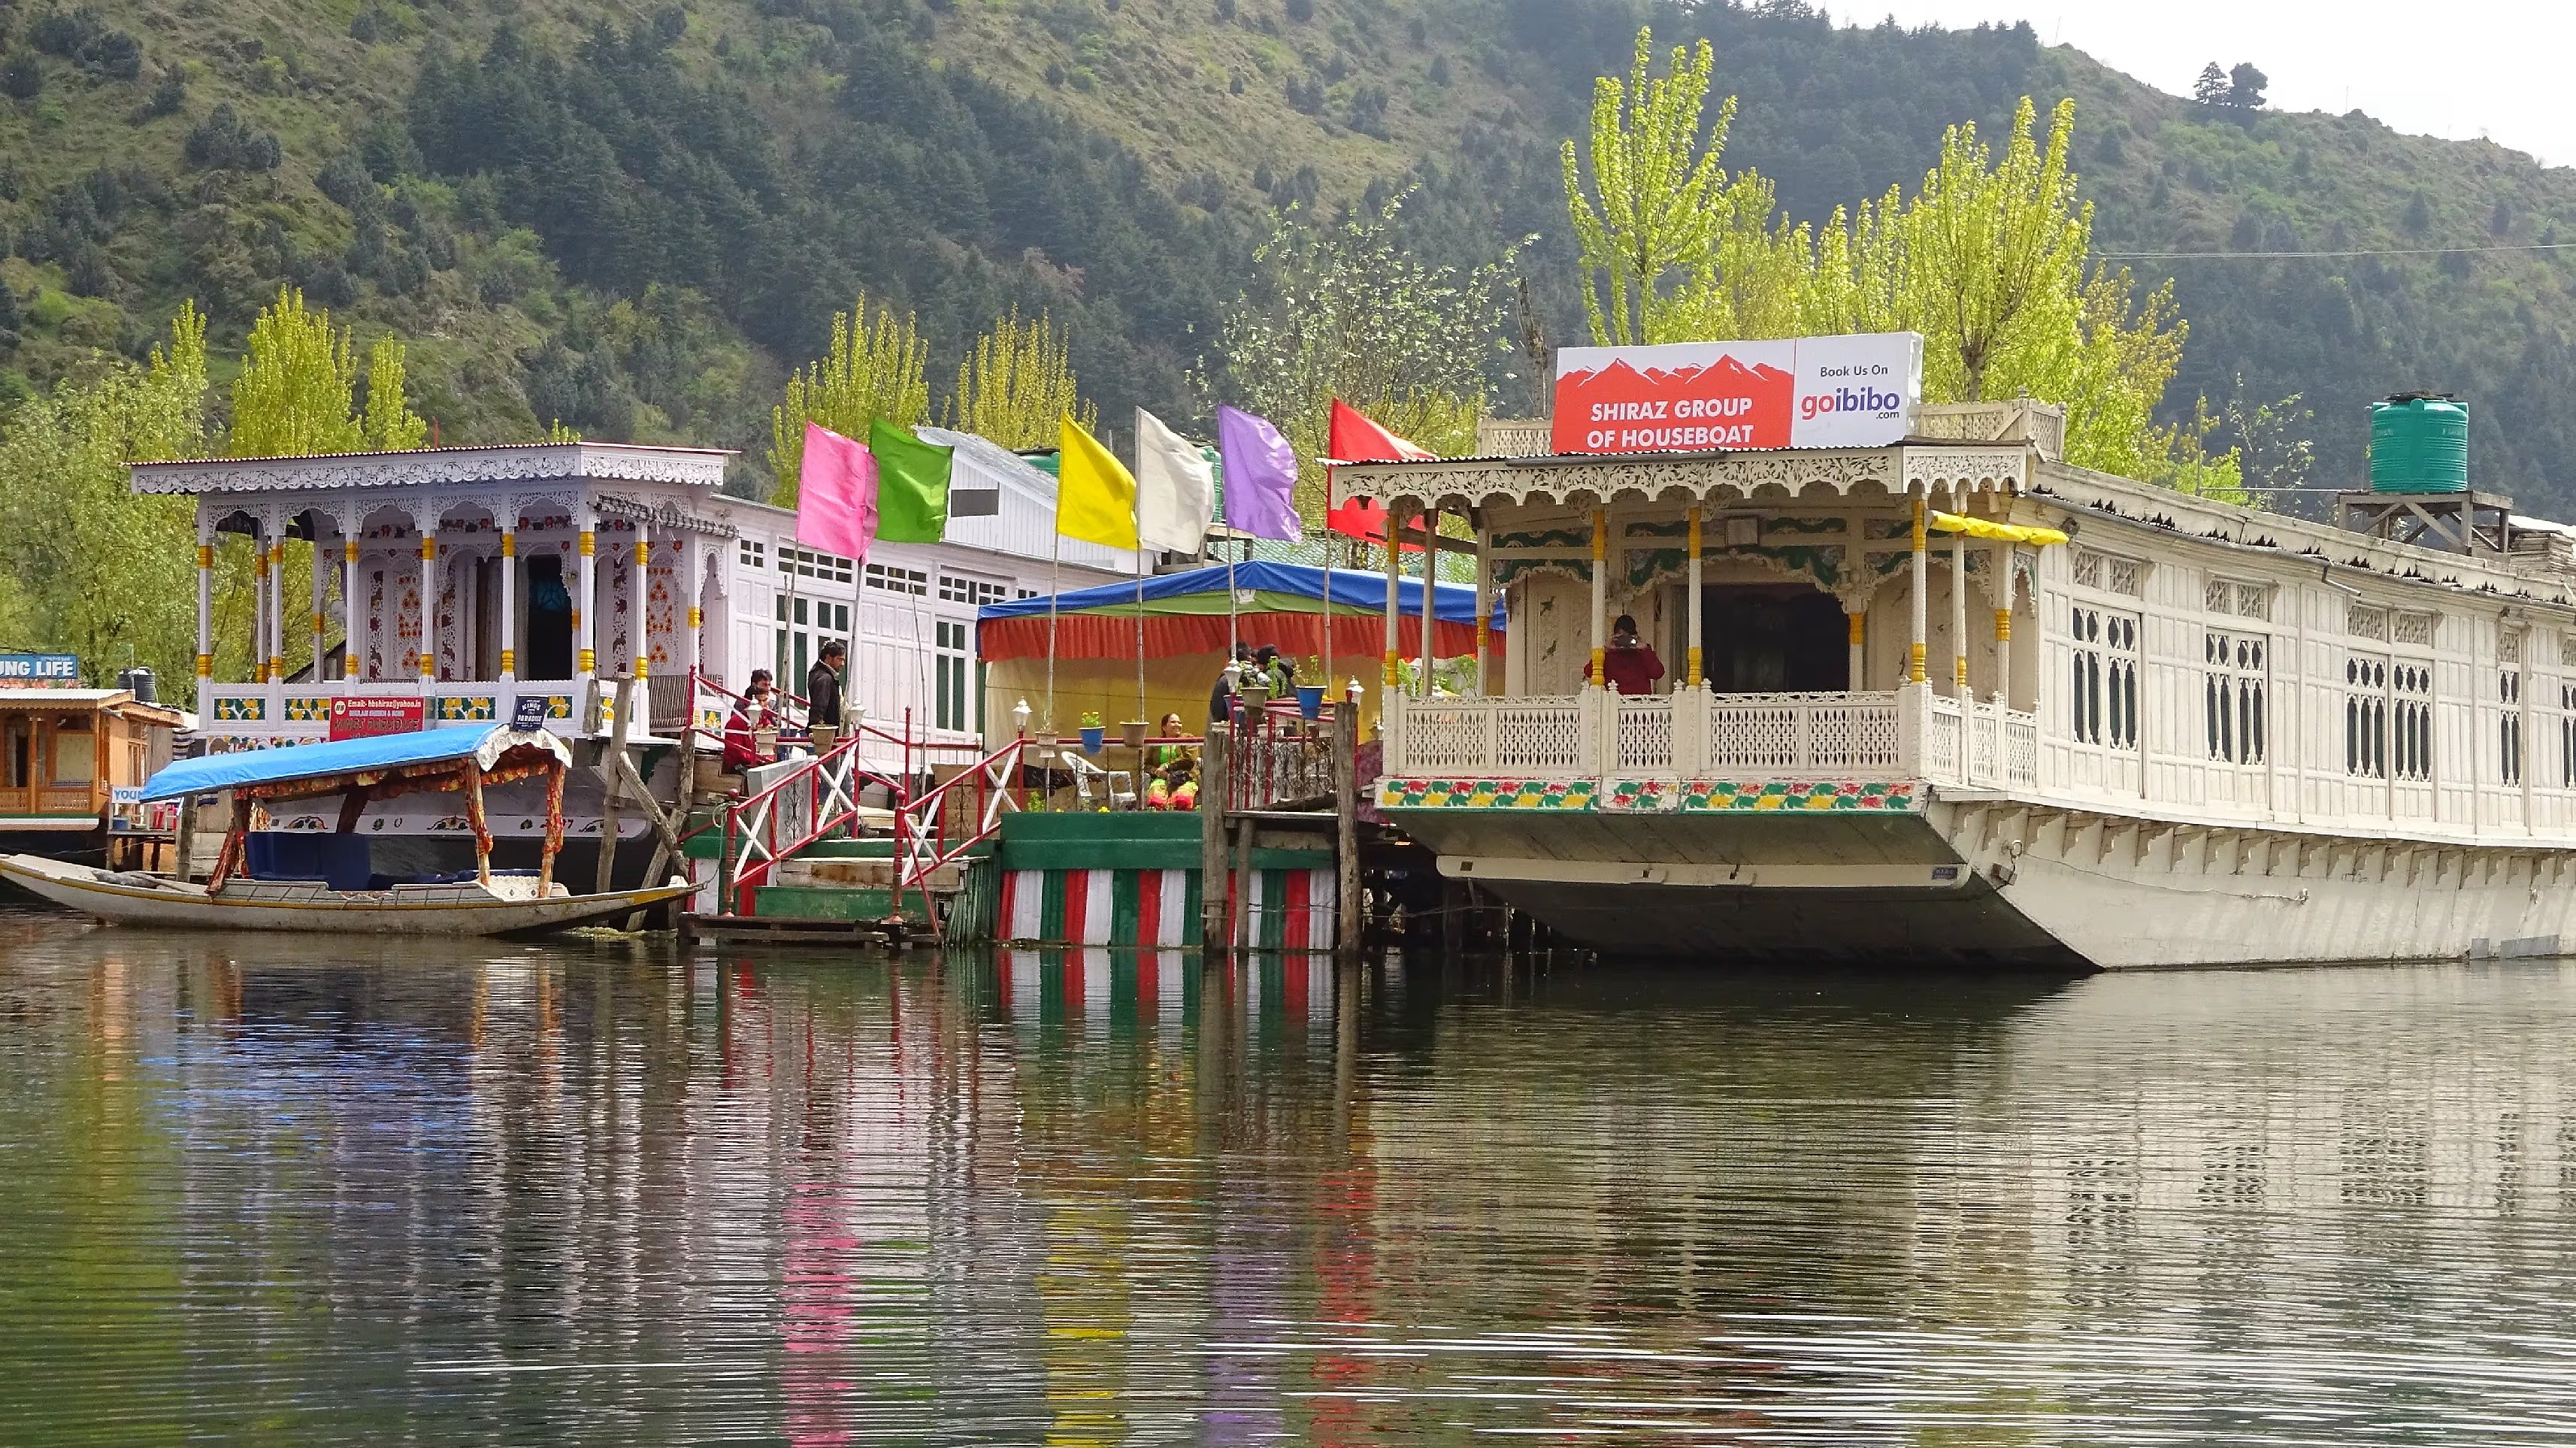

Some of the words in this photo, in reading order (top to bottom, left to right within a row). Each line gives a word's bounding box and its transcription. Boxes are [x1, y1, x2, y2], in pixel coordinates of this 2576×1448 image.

[1820, 366, 1850, 377] Book
[1854, 365, 1868, 376] Us
[1871, 365, 1888, 375] On
[1591, 401, 1669, 422] SHIRAZ
[1674, 398, 1753, 419] GROUP
[1801, 386, 1900, 420] goibibo
[1875, 411, 1899, 420] .com
[1587, 430, 1616, 448] OF
[1621, 425, 1754, 447] HOUSEBOAT
[36, 661, 73, 676] LIFE
